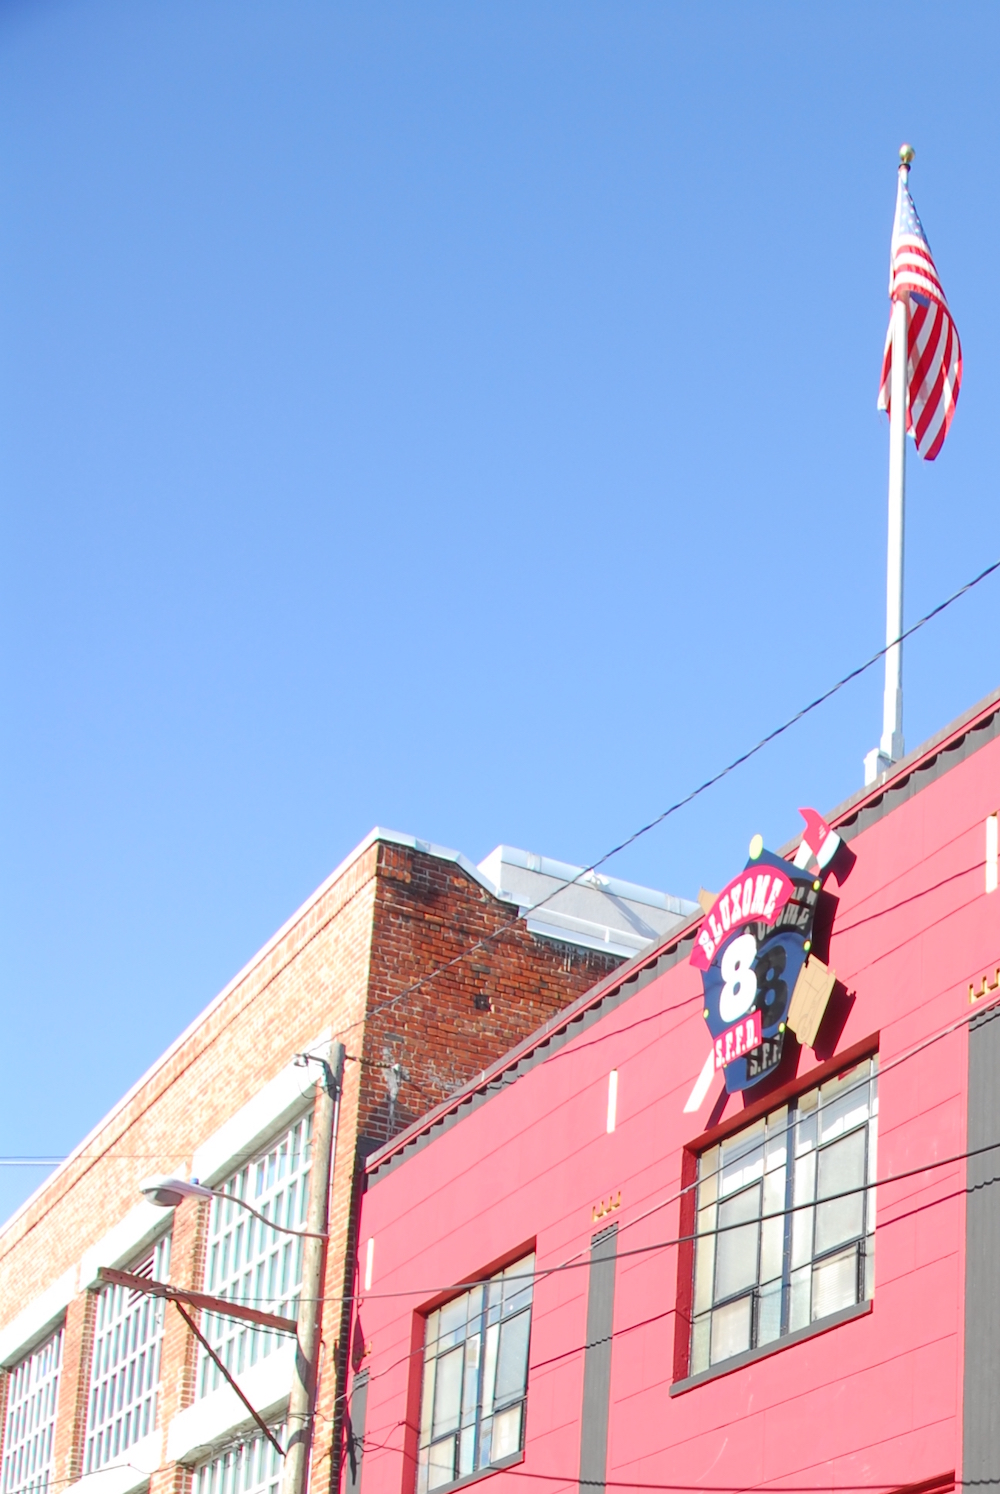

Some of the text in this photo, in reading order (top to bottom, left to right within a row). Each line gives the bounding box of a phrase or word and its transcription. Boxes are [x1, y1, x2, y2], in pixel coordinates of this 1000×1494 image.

[698, 875, 783, 960] BLUXOME
[718, 934, 757, 1023] 8
[716, 1019, 758, 1068] S.F.F.D.
